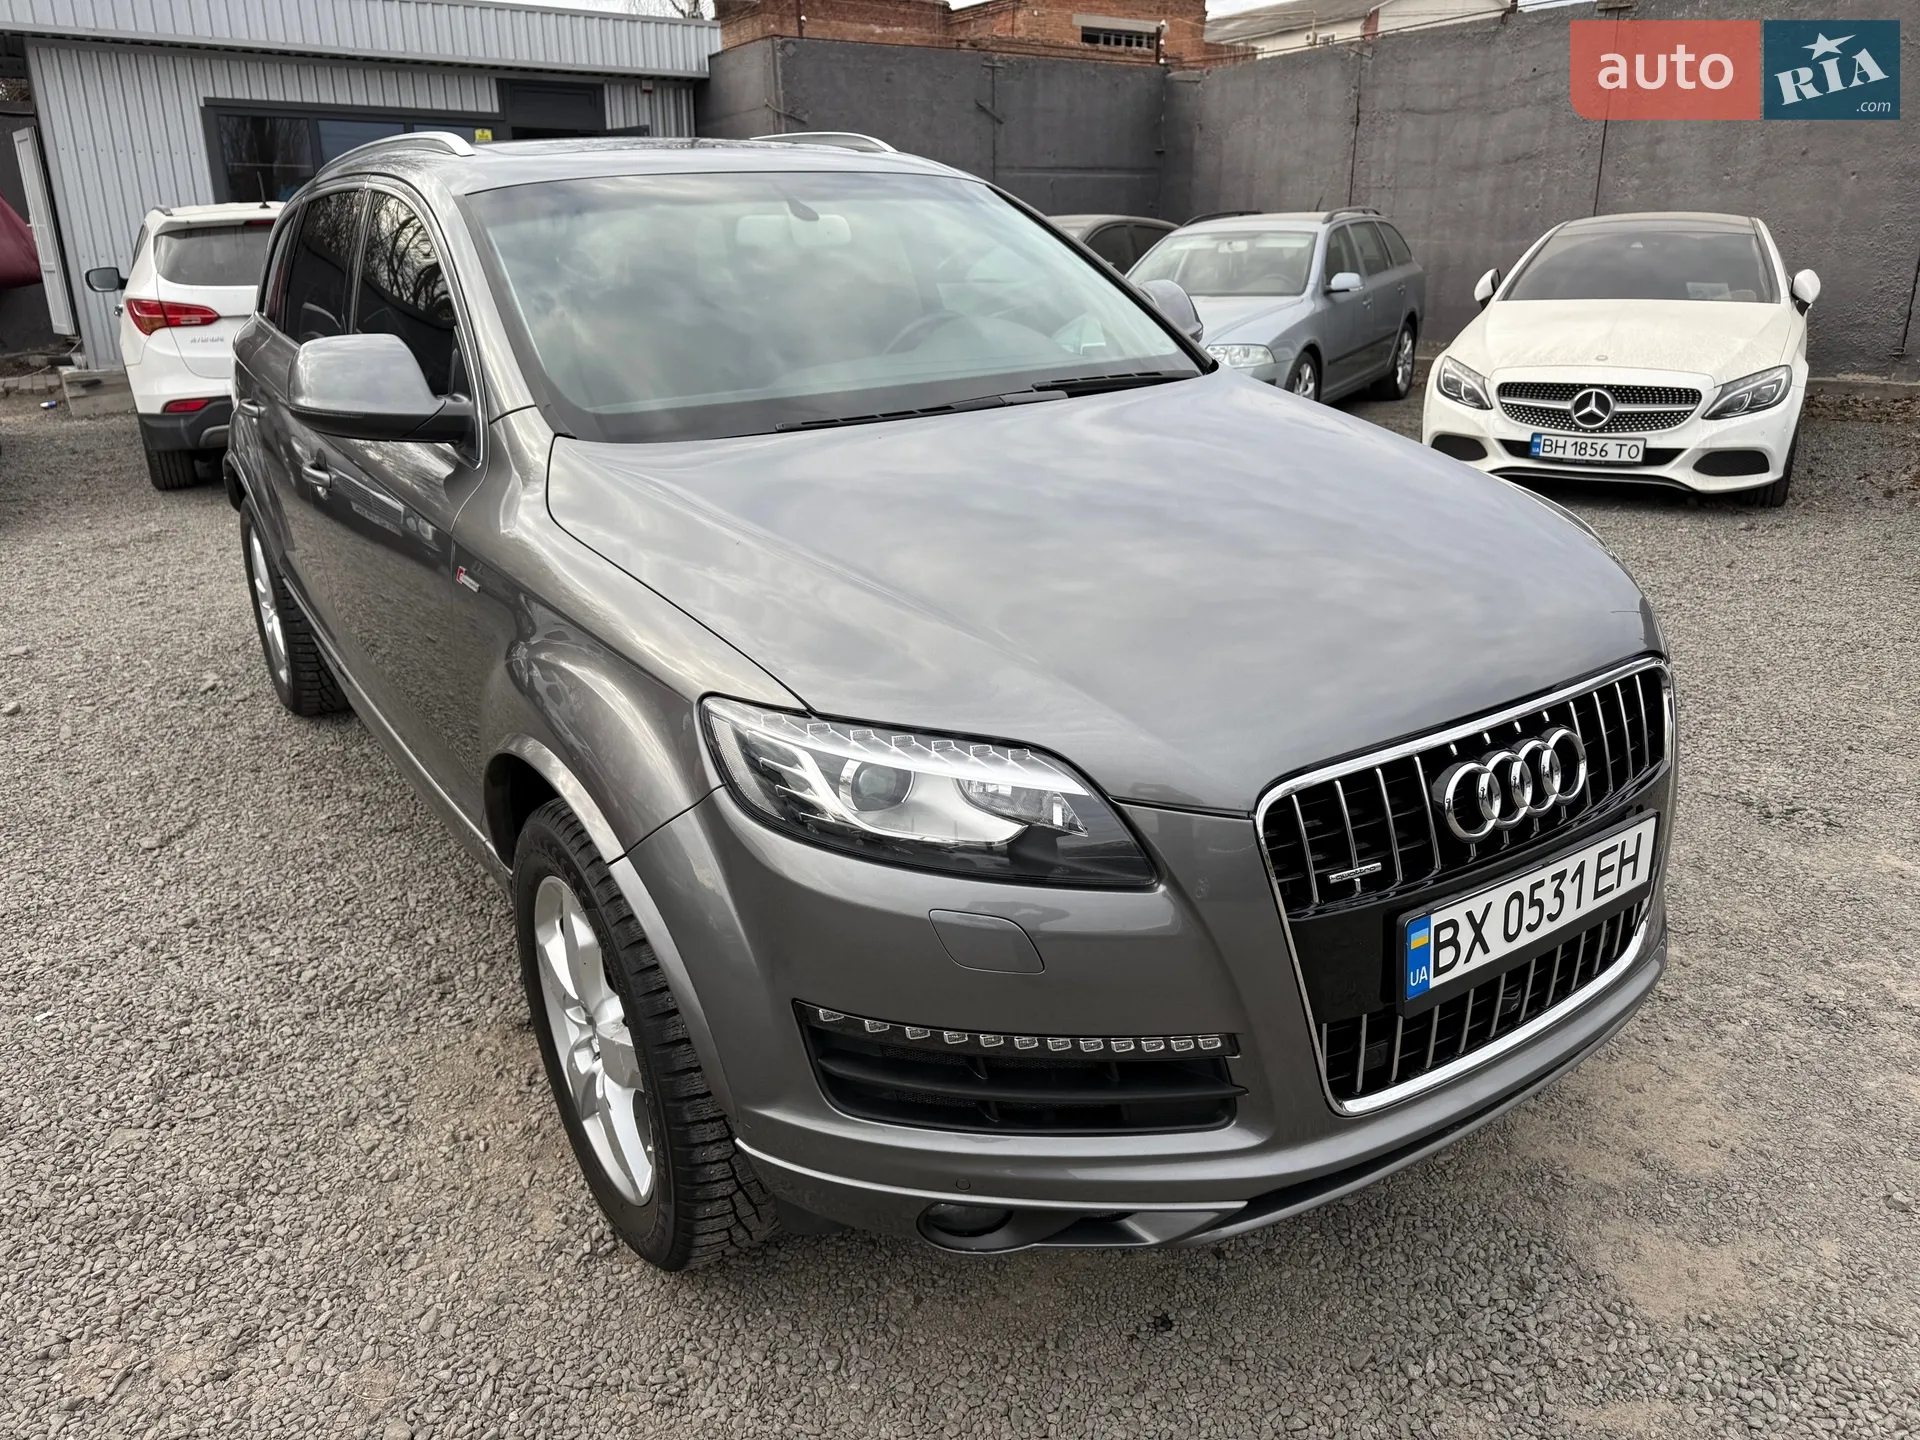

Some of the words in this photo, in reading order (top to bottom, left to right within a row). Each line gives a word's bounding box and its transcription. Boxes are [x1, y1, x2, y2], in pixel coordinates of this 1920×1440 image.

[1542, 438, 1567, 455] BH
[1570, 441, 1609, 458] 1856
[1615, 443, 1640, 459] TO
[1335, 866, 1377, 881] quattro
[1433, 901, 1492, 978] BX
[1503, 860, 1586, 943] 0531
[1593, 832, 1642, 900] EH
[1410, 965, 1428, 987] UA
